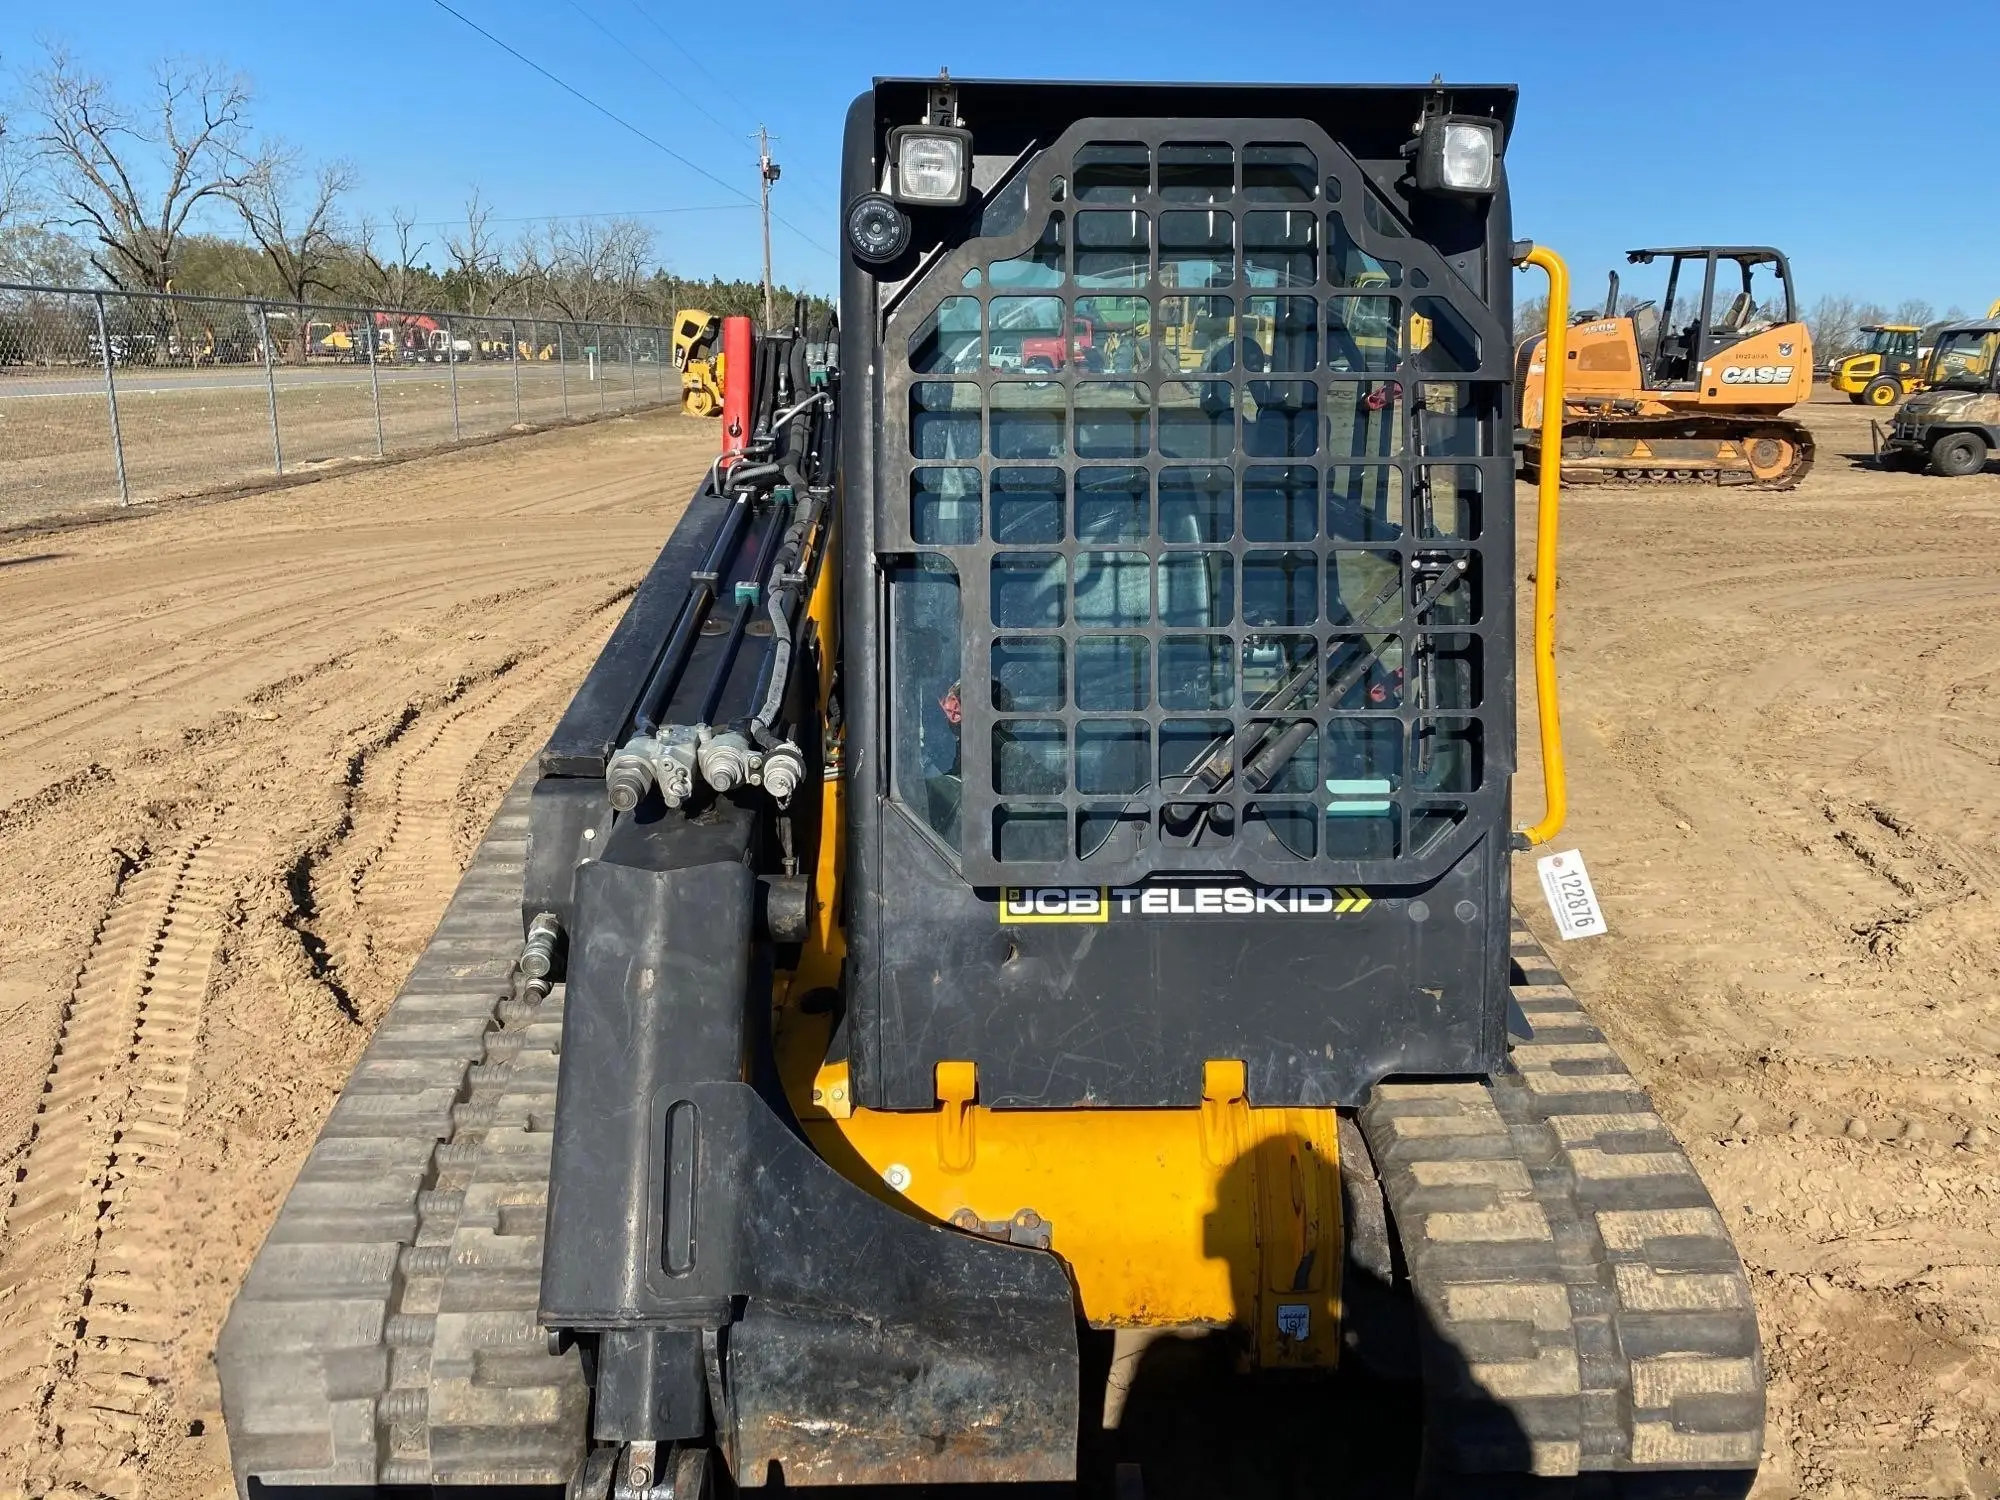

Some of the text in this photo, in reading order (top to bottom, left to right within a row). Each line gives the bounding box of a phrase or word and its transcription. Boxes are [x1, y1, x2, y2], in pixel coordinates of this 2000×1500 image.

[1721, 366, 1794, 384] CASE
[1008, 888, 1333, 914] JCB TELESKID
[1559, 870, 1596, 927] 122876
